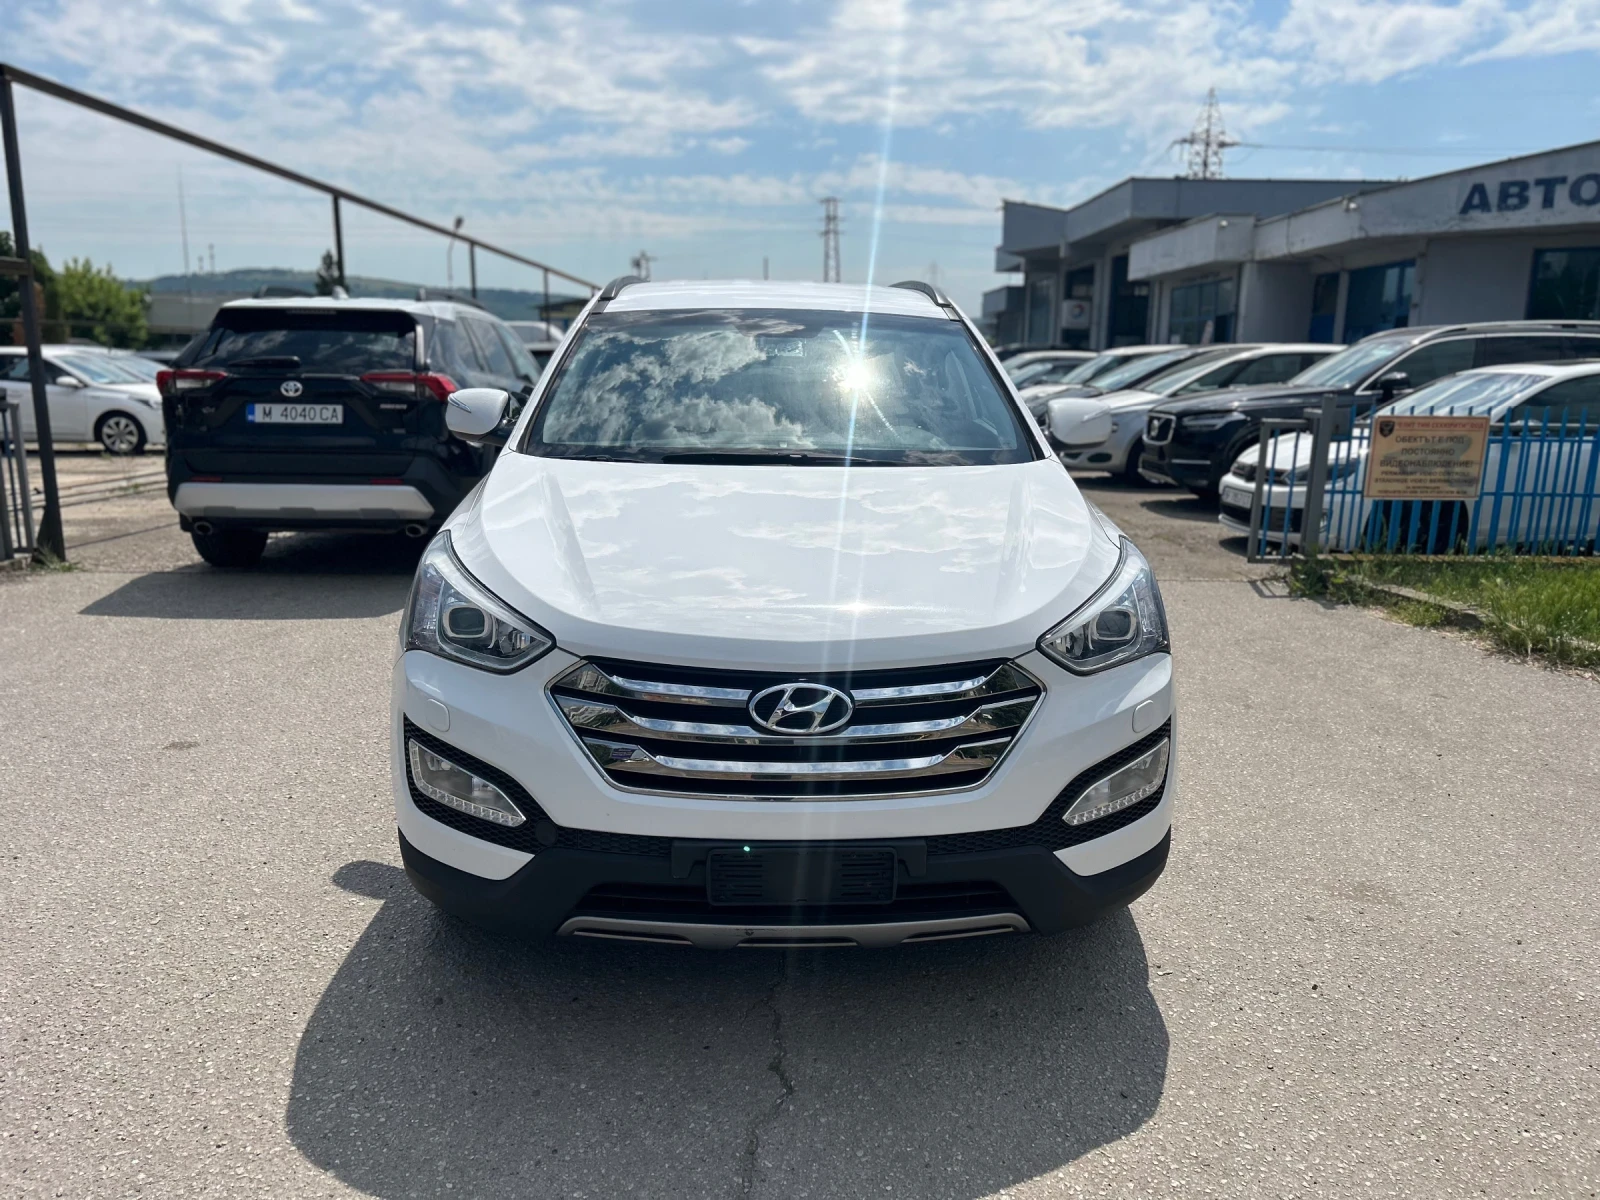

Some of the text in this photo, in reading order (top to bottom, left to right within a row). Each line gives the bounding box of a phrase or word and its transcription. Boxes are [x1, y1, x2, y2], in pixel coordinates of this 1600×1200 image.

[1459, 172, 1600, 215] АВТО
[262, 406, 339, 421] M 4040 CA
[1400, 447, 1455, 456] ПОСТОЯННО
